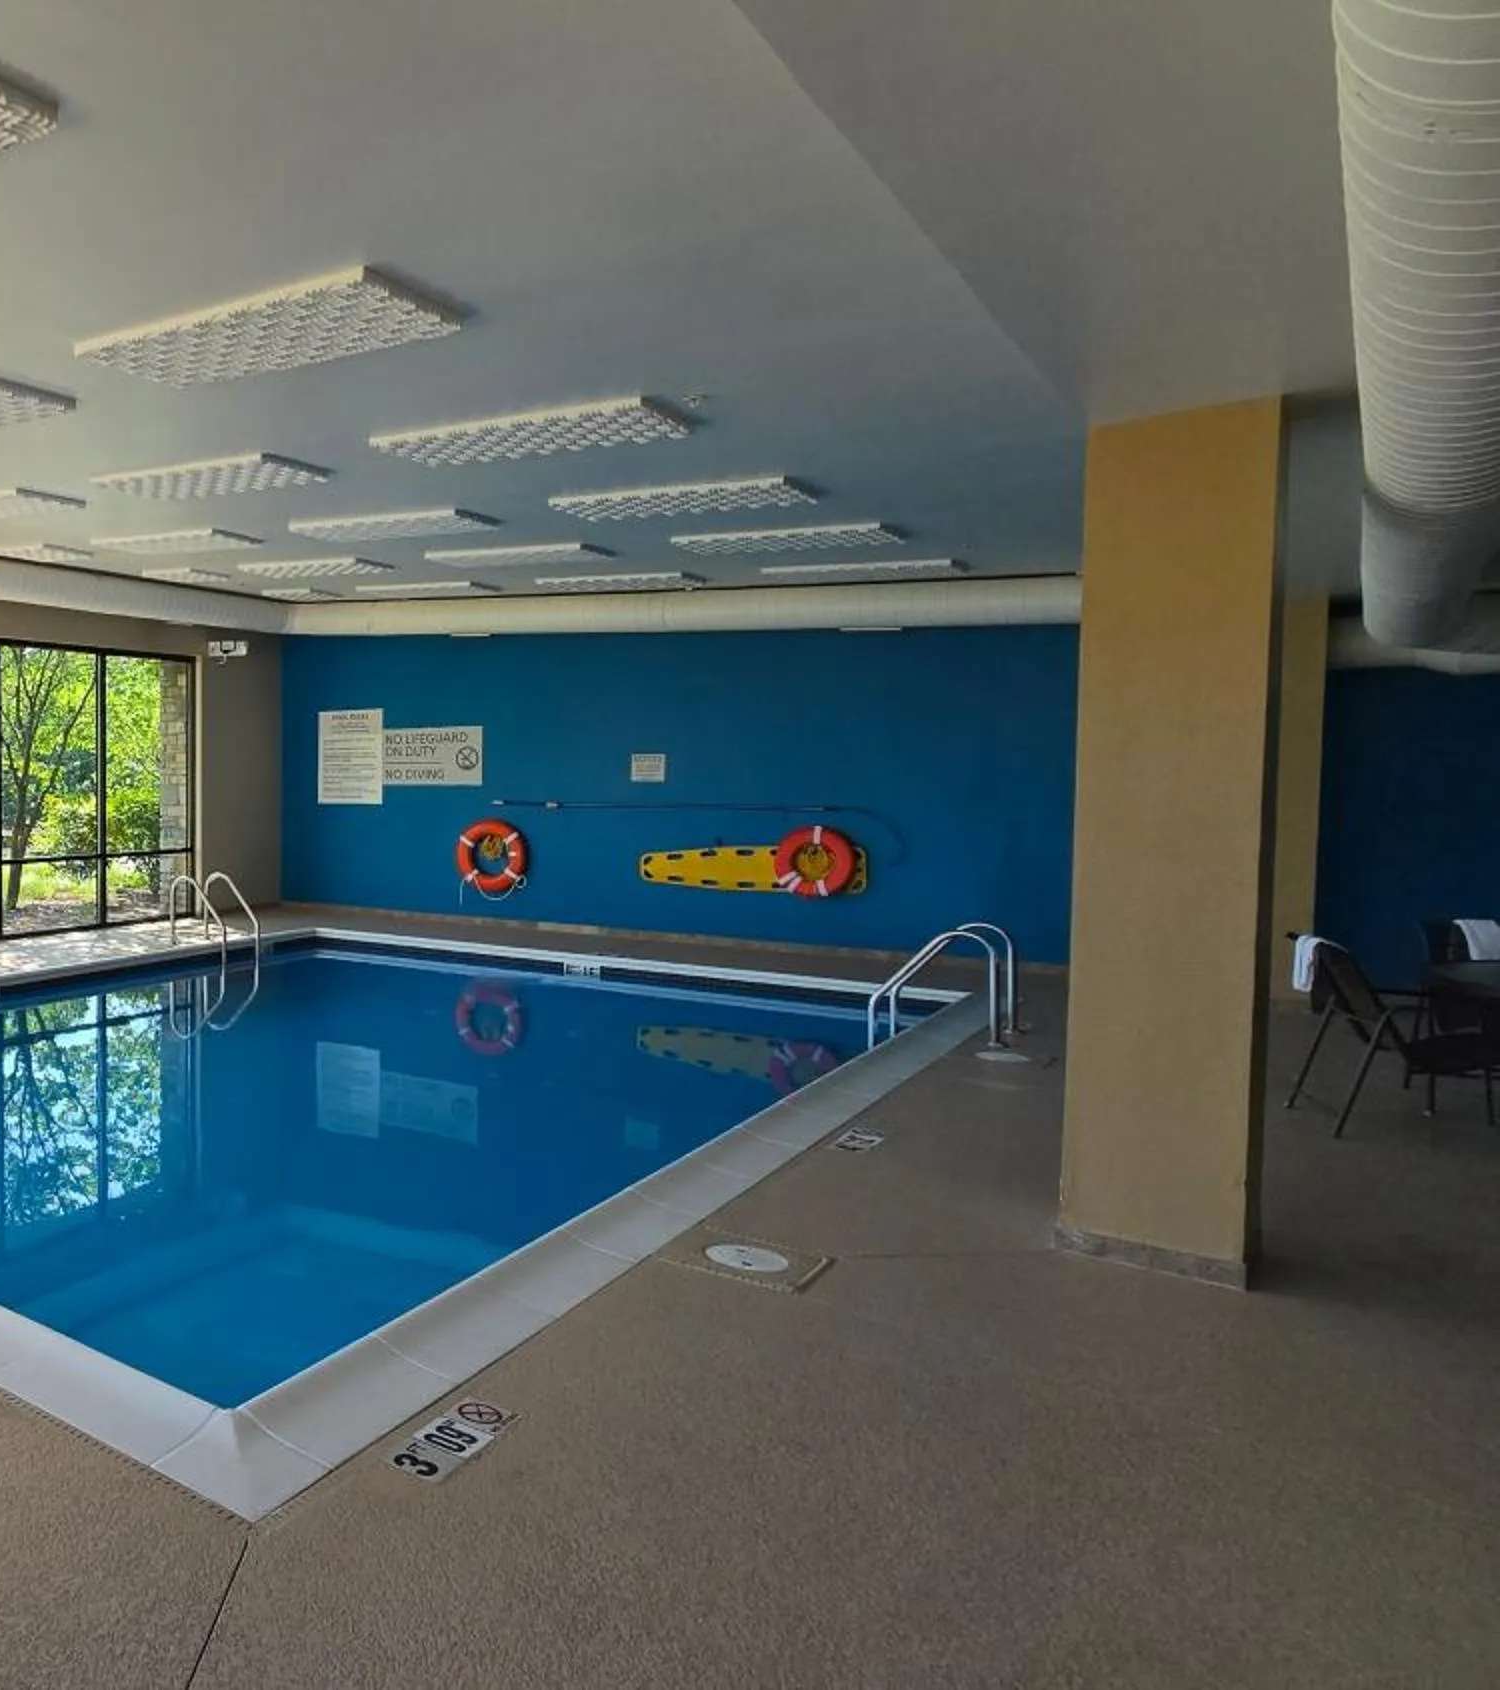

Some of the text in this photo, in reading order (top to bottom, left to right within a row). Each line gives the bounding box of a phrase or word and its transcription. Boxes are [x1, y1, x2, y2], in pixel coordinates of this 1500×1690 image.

[385, 731, 469, 745] NO LIFEGUARD
[385, 745, 437, 757] ON DUTY
[385, 768, 445, 780] NO DIVING
[393, 1453, 439, 1477] 3
[424, 1425, 479, 1453] 09
